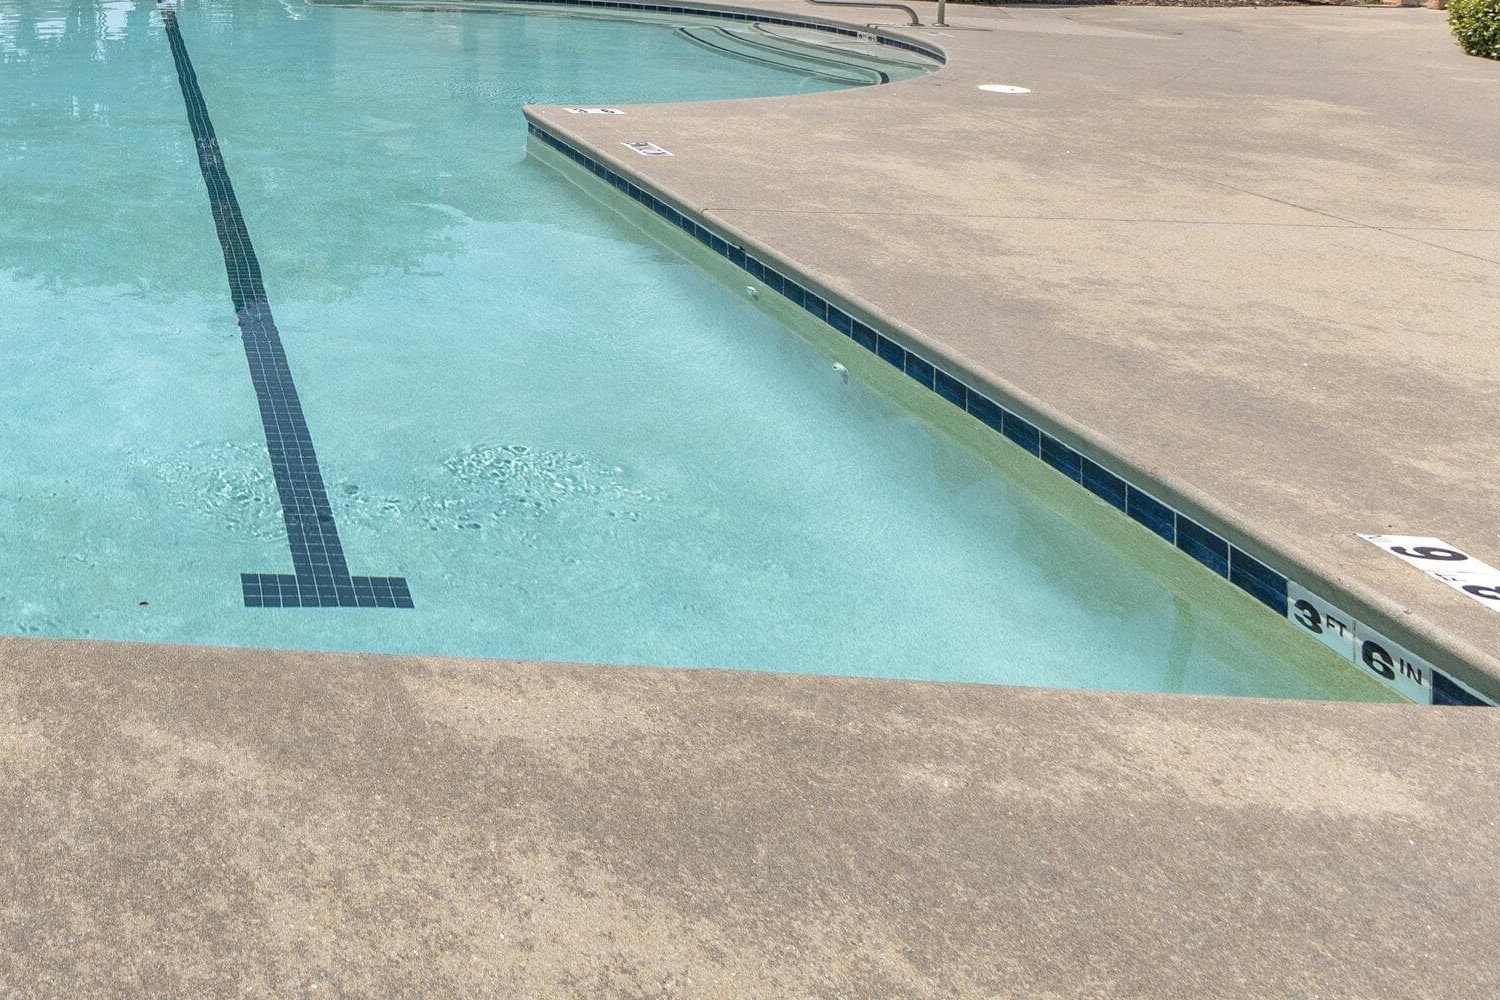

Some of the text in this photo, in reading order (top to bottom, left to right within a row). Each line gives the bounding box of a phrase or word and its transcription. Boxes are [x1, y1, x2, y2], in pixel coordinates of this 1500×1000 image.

[1294, 599, 1422, 685] 3 FT 6 IN
